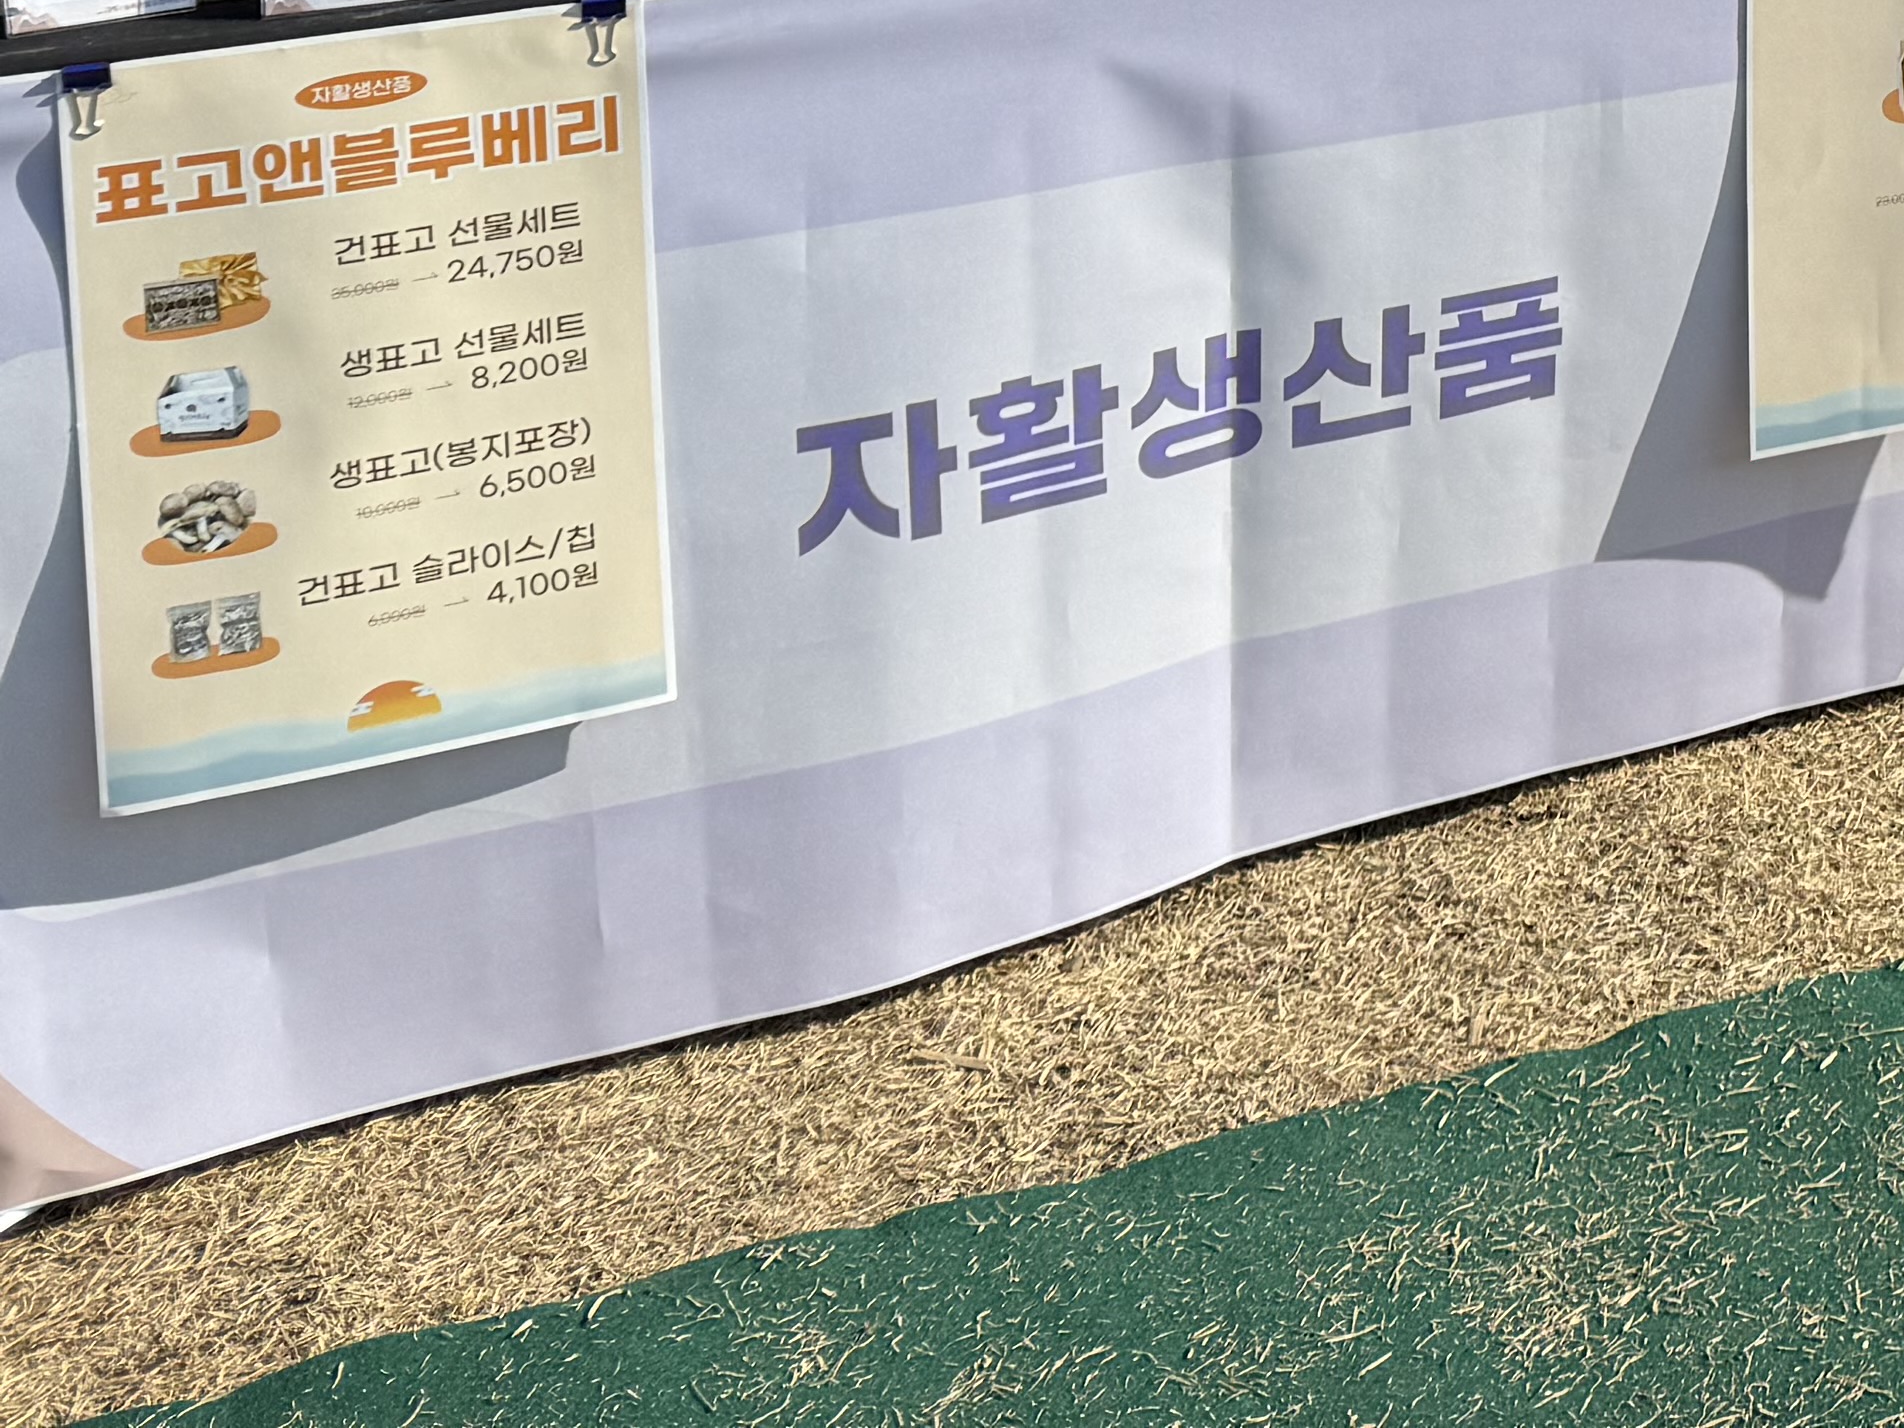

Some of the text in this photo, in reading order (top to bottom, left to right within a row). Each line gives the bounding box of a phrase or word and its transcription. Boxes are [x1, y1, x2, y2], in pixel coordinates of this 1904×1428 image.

[310, 73, 412, 105] 자활생산품
[93, 93, 624, 226] 표고앤블루베리
[333, 201, 583, 267] 건표고 선물세트
[446, 239, 586, 287] 24,750원
[339, 311, 588, 380] 생표고 선물세트
[469, 347, 590, 391] 8,200원
[795, 274, 1565, 558] 자활생산품
[328, 416, 594, 492] 생표고(봉지포장)
[477, 454, 598, 501] 6,500원
[295, 521, 598, 608] 건표고 슬라이스/칩
[485, 562, 601, 609] 4,100원
